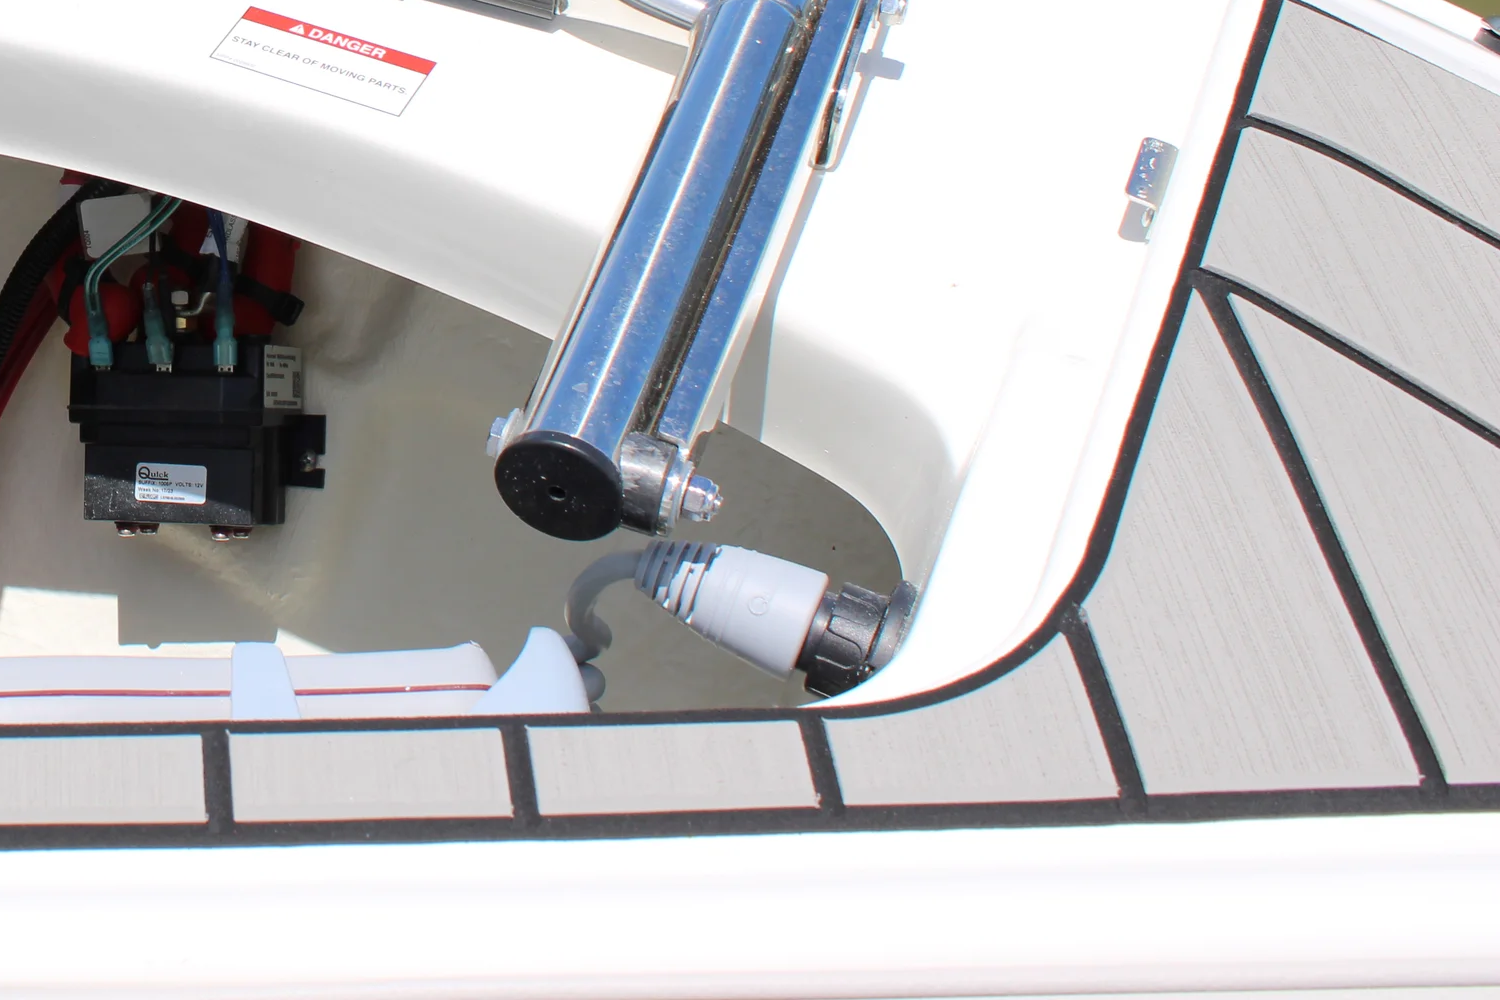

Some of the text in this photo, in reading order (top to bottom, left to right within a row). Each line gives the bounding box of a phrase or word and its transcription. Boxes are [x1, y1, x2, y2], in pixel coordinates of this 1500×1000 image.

[231, 35, 259, 49] STAY
[262, 45, 299, 61] CLEAR
[302, 57, 319, 67] OF
[319, 62, 366, 82] MOVING
[308, 28, 386, 59] DANGER
[138, 466, 169, 481] Quick
